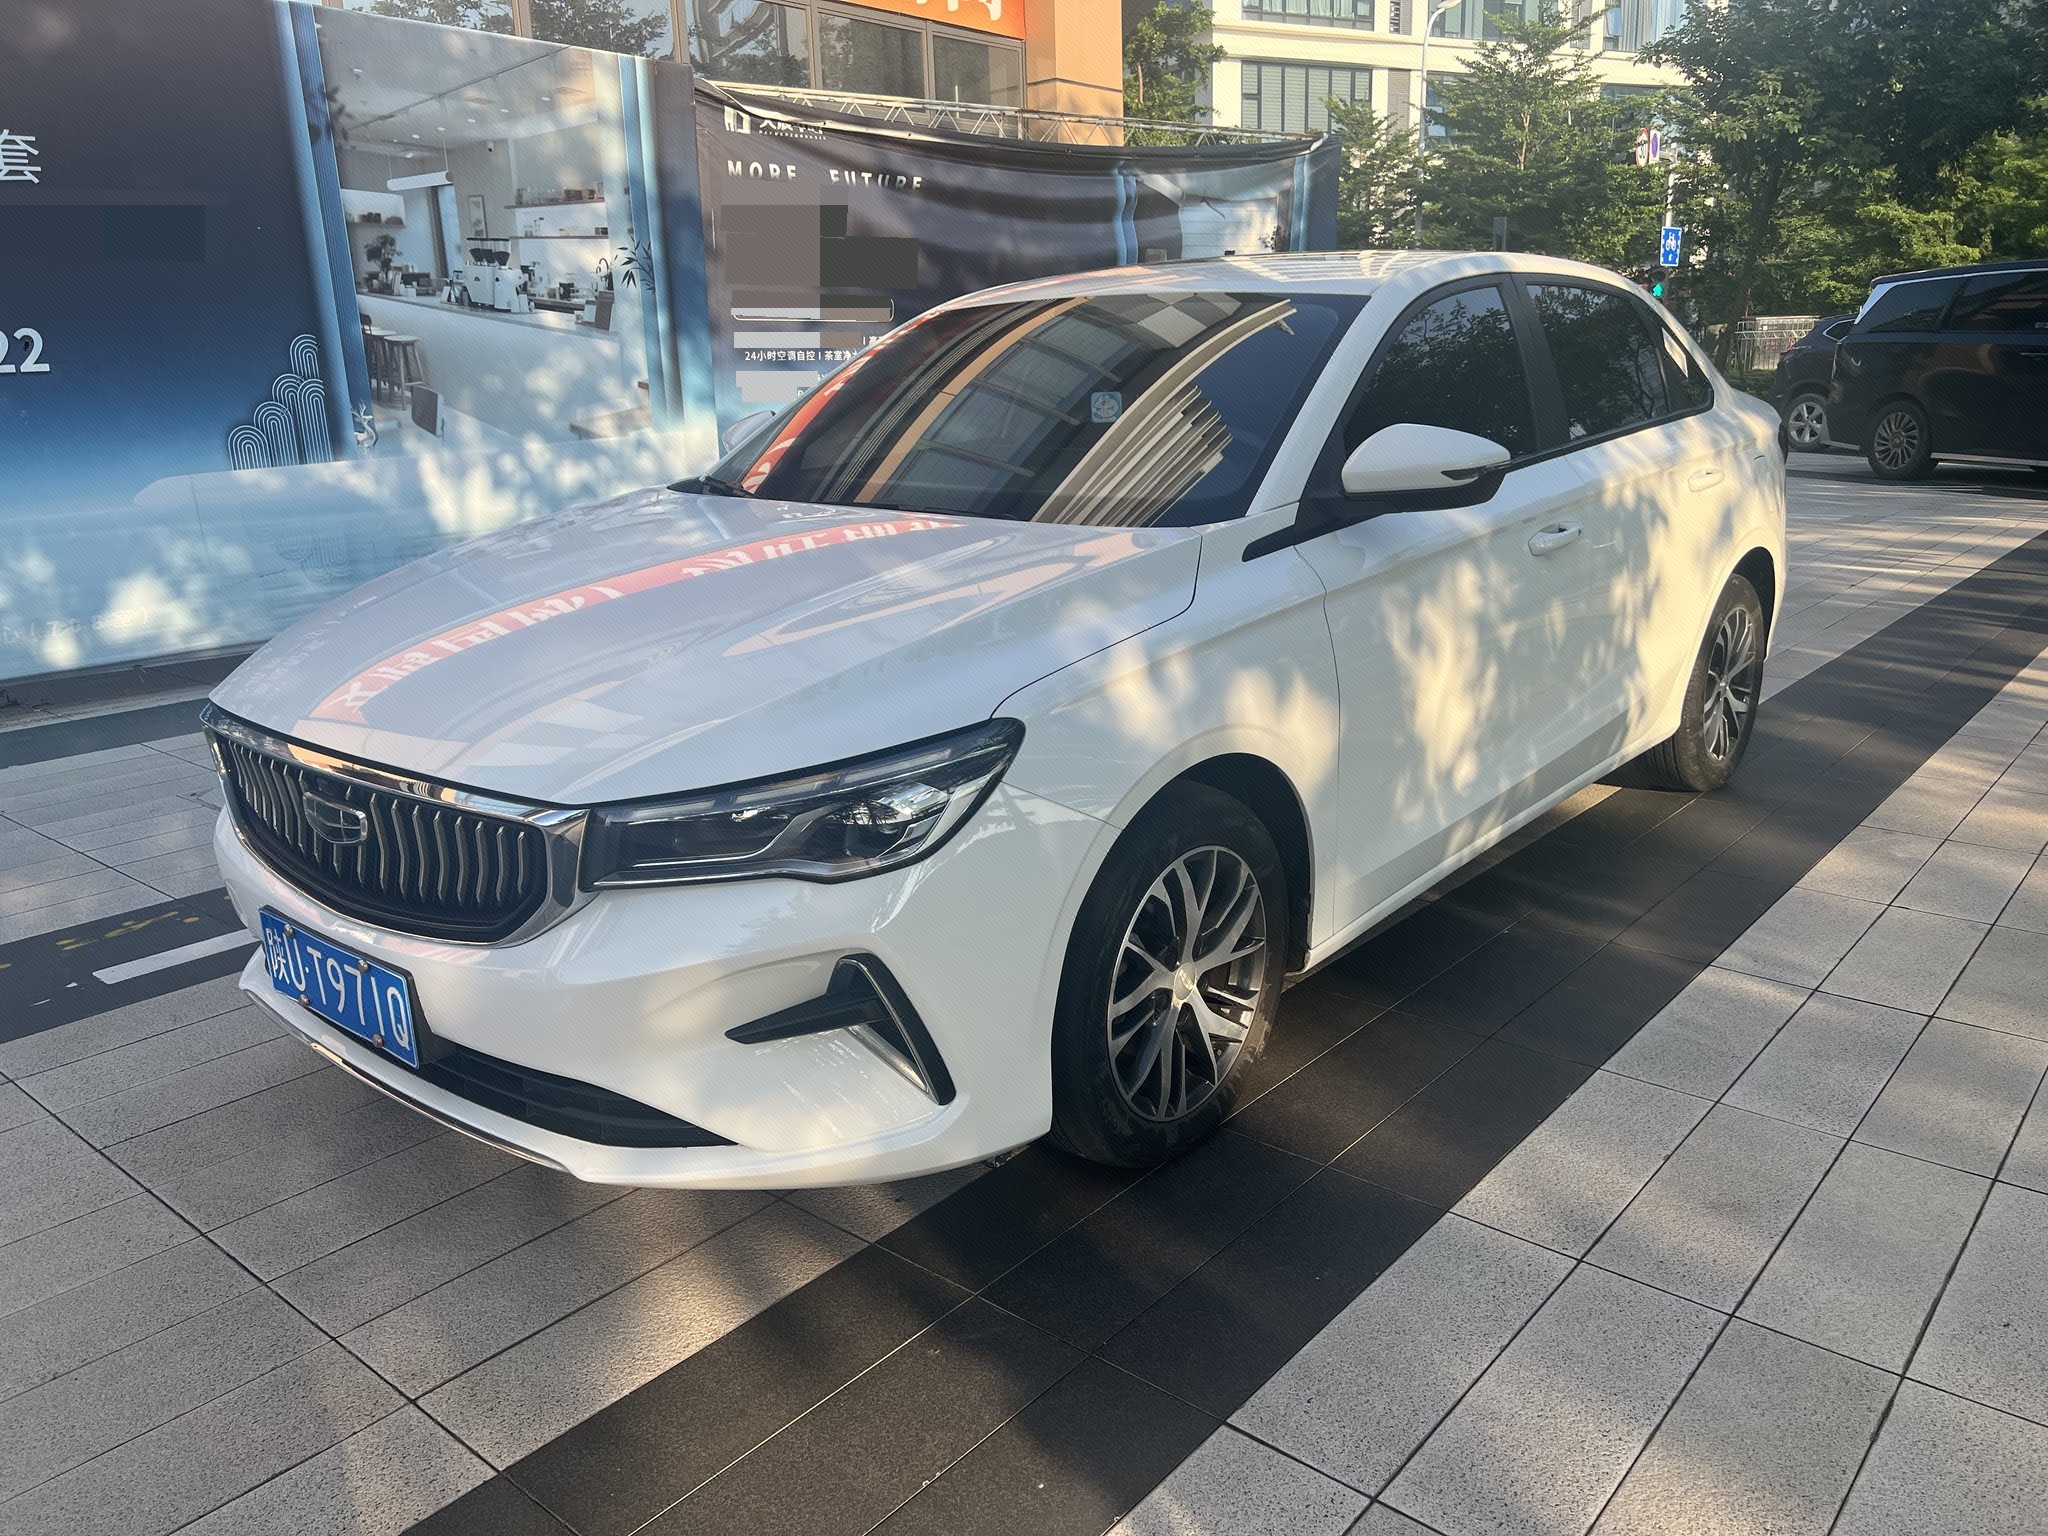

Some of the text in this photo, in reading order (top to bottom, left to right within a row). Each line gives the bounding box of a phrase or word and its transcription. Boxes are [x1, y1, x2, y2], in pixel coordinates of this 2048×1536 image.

[0, 129, 42, 184] 套
[727, 160, 924, 190] MORE FUTURE
[744, 350, 816, 362] 24小时空调自控
